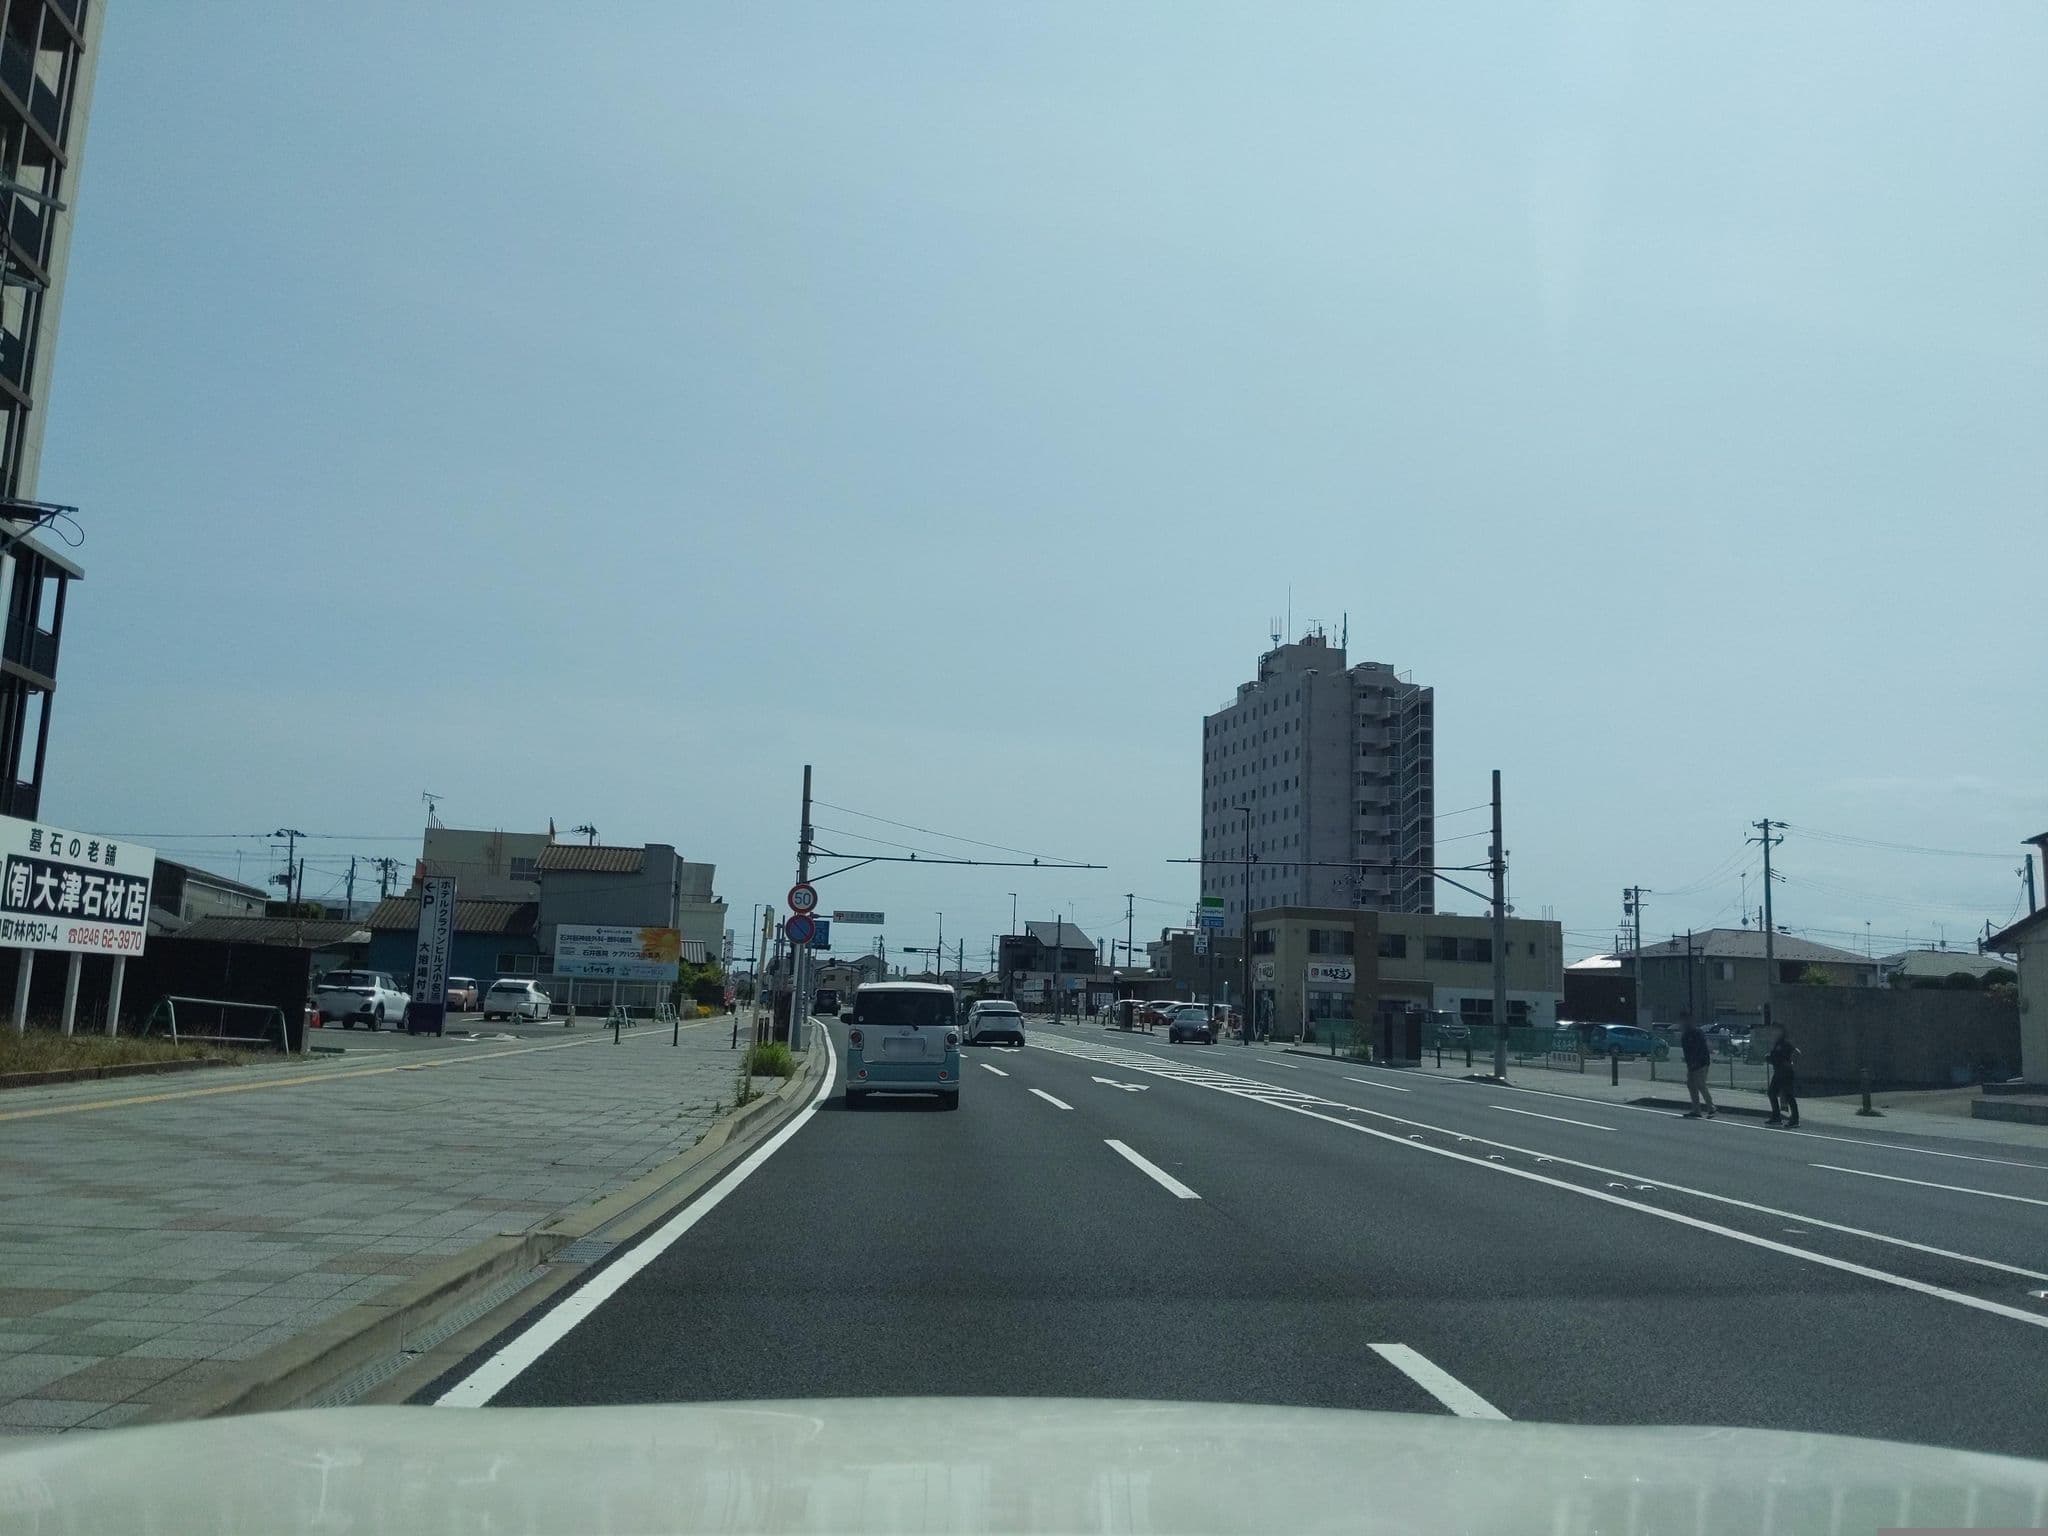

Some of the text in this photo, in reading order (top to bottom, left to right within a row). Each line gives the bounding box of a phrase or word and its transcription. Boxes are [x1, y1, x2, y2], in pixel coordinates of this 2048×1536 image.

[29, 827, 117, 866] 墓石の老舗
[6, 861, 146, 921] (有)大津石材店
[423, 895, 434, 908] P
[794, 892, 811, 906] 50
[0, 918, 58, 943] 町林内31-4
[78, 928, 142, 950] 0246 62-3970
